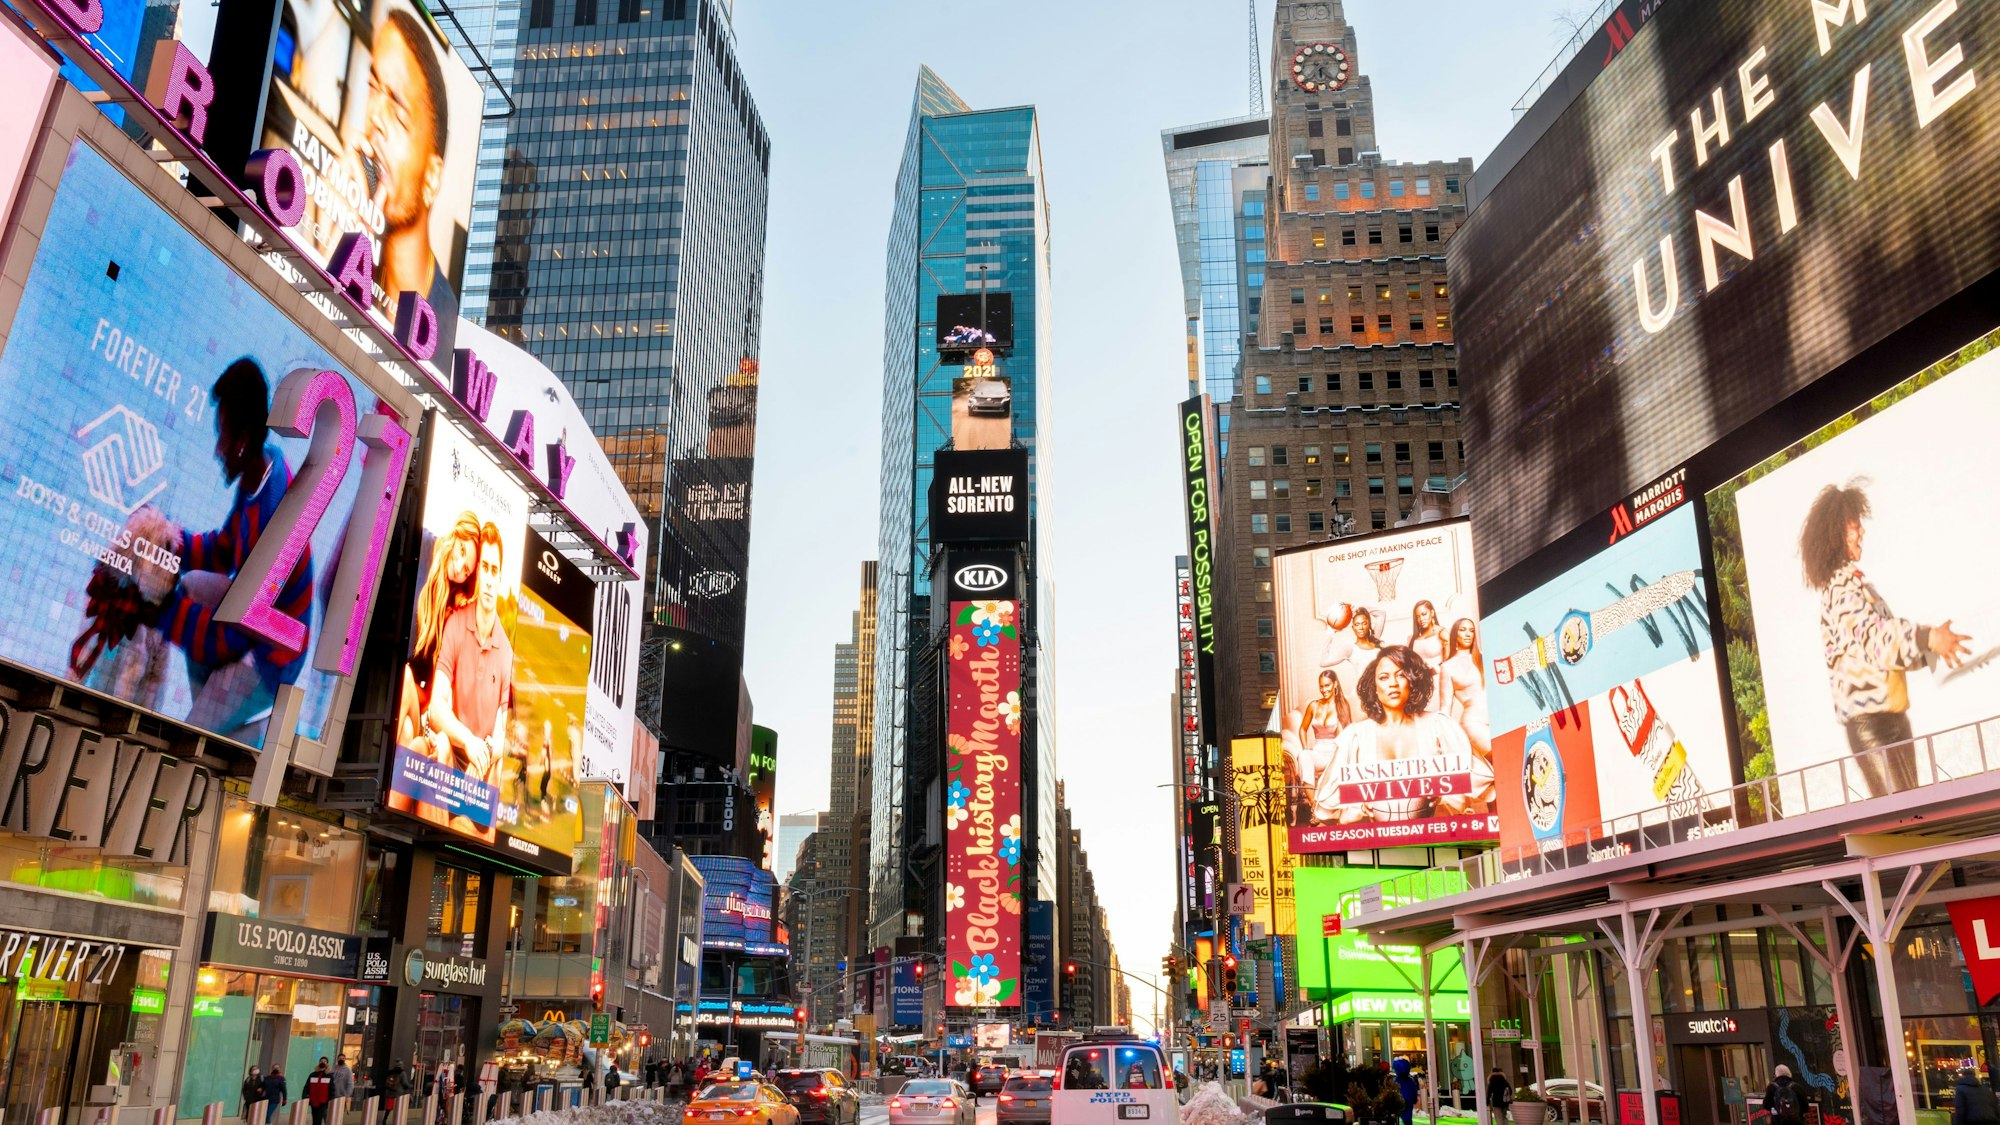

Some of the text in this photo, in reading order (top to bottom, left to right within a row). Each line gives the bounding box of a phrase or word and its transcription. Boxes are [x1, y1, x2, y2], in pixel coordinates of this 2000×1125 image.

[1650, 45, 1775, 195] THE
[292, 119, 386, 234] RAYMOND
[1632, 0, 1978, 334] UNIVE
[290, 147, 382, 266] OBINSON
[91, 318, 207, 422] FOREVER 21
[964, 365, 995, 378] 2021
[949, 476, 1013, 494] ALL-NEW
[1633, 468, 1686, 508] MARRIOTT
[947, 495, 1014, 514] SORENTO
[1635, 488, 1683, 524] MARQUIS
[17, 476, 182, 576] BOYS & GIRLS CLUBS
[225, 368, 412, 676] 21
[1186, 412, 1215, 654] OPEN FOR POSSIBILITY
[60, 528, 134, 576] OF AMERICA
[1328, 554, 1345, 563] ONE
[1347, 550, 1367, 560] SHOT
[1379, 541, 1414, 554] MAKING
[1416, 536, 1442, 548] PEACE
[537, 561, 562, 585] OAKLEY
[964, 570, 998, 586] KIA
[1184, 714, 1197, 732] &
[405, 756, 425, 774] LIVE
[428, 767, 490, 801] AUTHENTICALLY
[1340, 755, 1470, 783] BASKETBALL
[966, 646, 1008, 955] Black history Month
[1358, 776, 1453, 801] WIVES
[723, 785, 734, 831] 1500
[1201, 804, 1219, 814] OPEN
[1302, 832, 1327, 843] NEW
[1330, 827, 1374, 841] SEASON
[1376, 824, 1424, 838] TUESDAY
[1428, 822, 1447, 834] FEB
[1450, 821, 1457, 832] 9
[508, 837, 539, 857] OAKLEY.COM
[1243, 857, 1260, 866] THE
[1246, 870, 1264, 879] ION
[1253, 887, 1268, 897] NG
[238, 922, 346, 960] U.S. POLO ASSN.
[0, 932, 126, 986] REVER 21
[273, 954, 308, 968] SINCE 1890
[365, 960, 387, 968] POLO
[366, 952, 381, 961] U.S.
[364, 967, 388, 976] ASSN.
[424, 957, 487, 989] sunglass hut
[1213, 1013, 1226, 1021] 25
[1352, 998, 1387, 1012] NEW
[1391, 998, 1434, 1013] YOR
[1689, 1018, 1729, 1034] swatch
